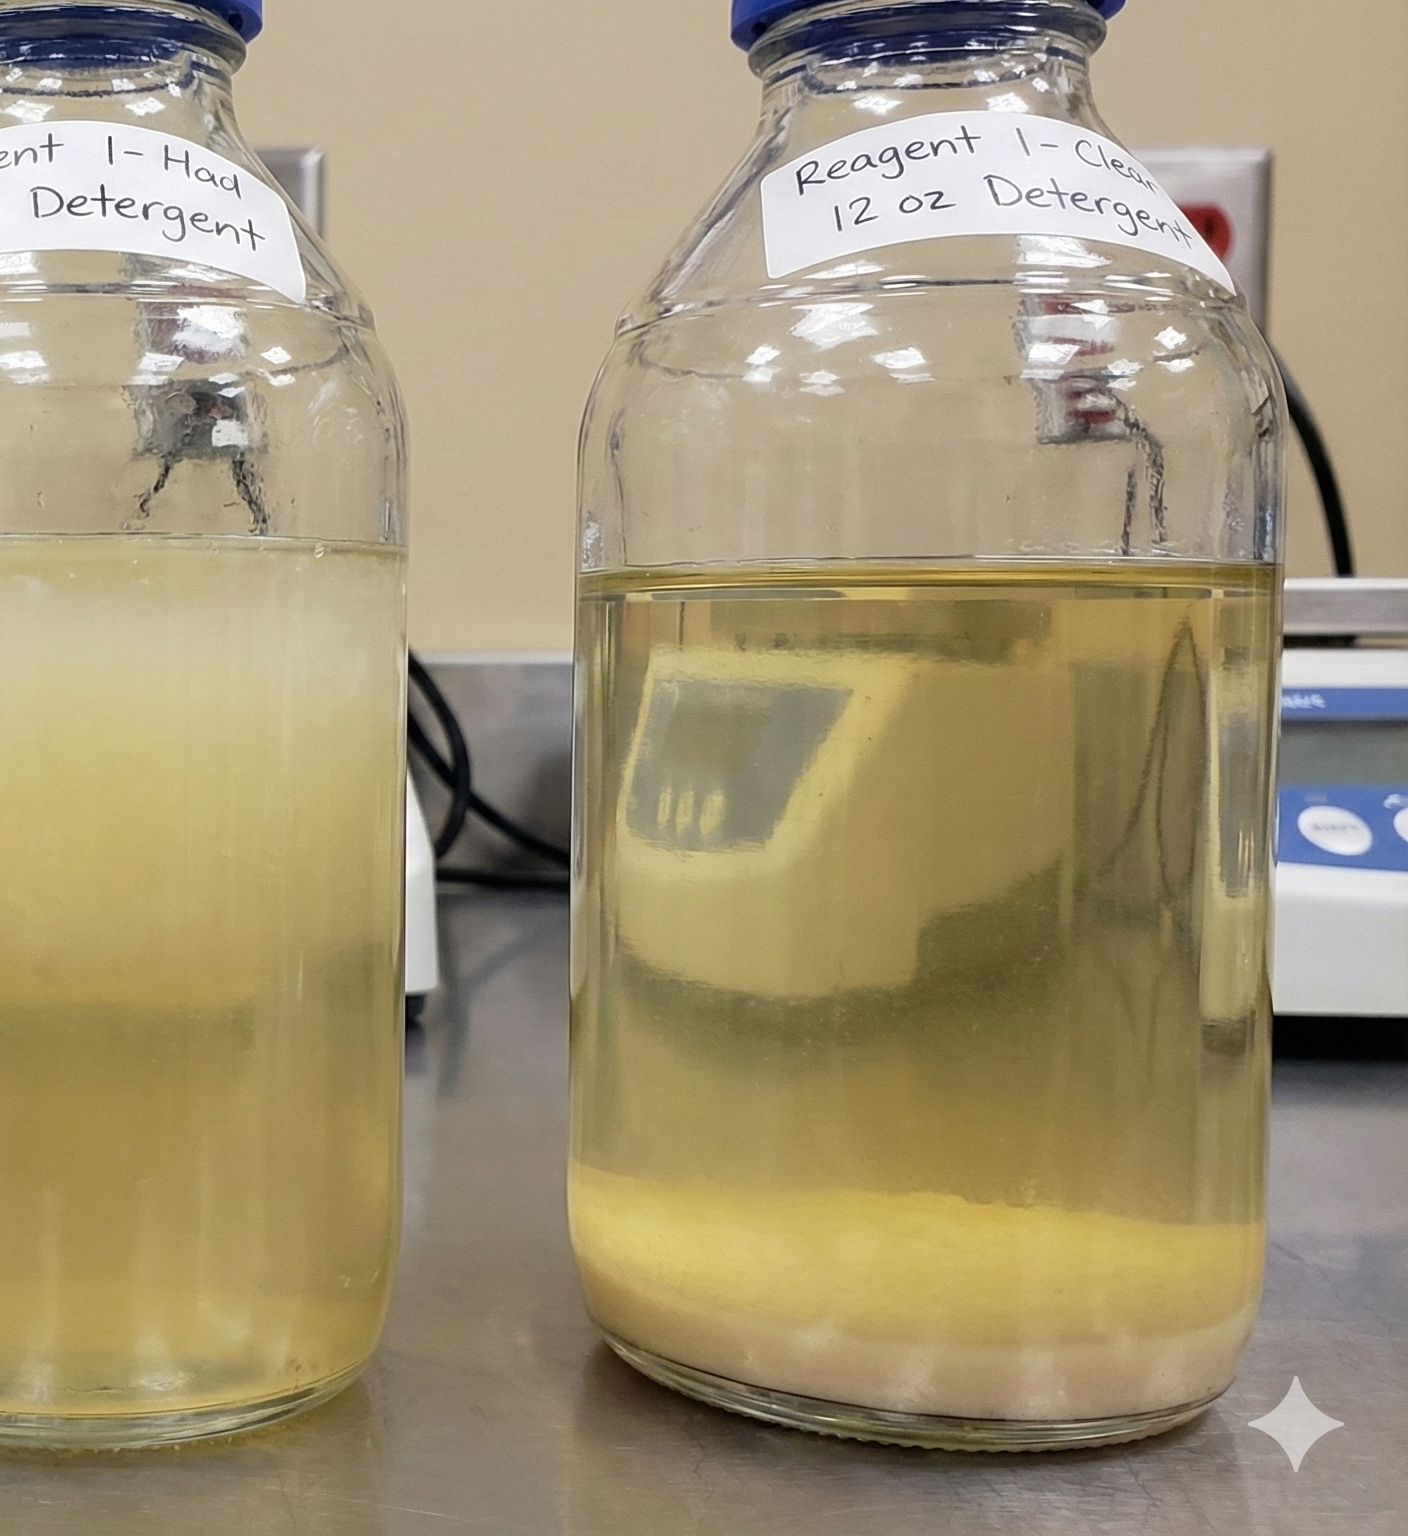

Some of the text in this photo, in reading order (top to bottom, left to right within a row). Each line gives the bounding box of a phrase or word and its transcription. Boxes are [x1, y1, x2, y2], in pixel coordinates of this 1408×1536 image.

[795, 125, 982, 196] Reagent
[29, 183, 267, 253] Detergent
[834, 174, 1194, 250] 12 oz Detergent
